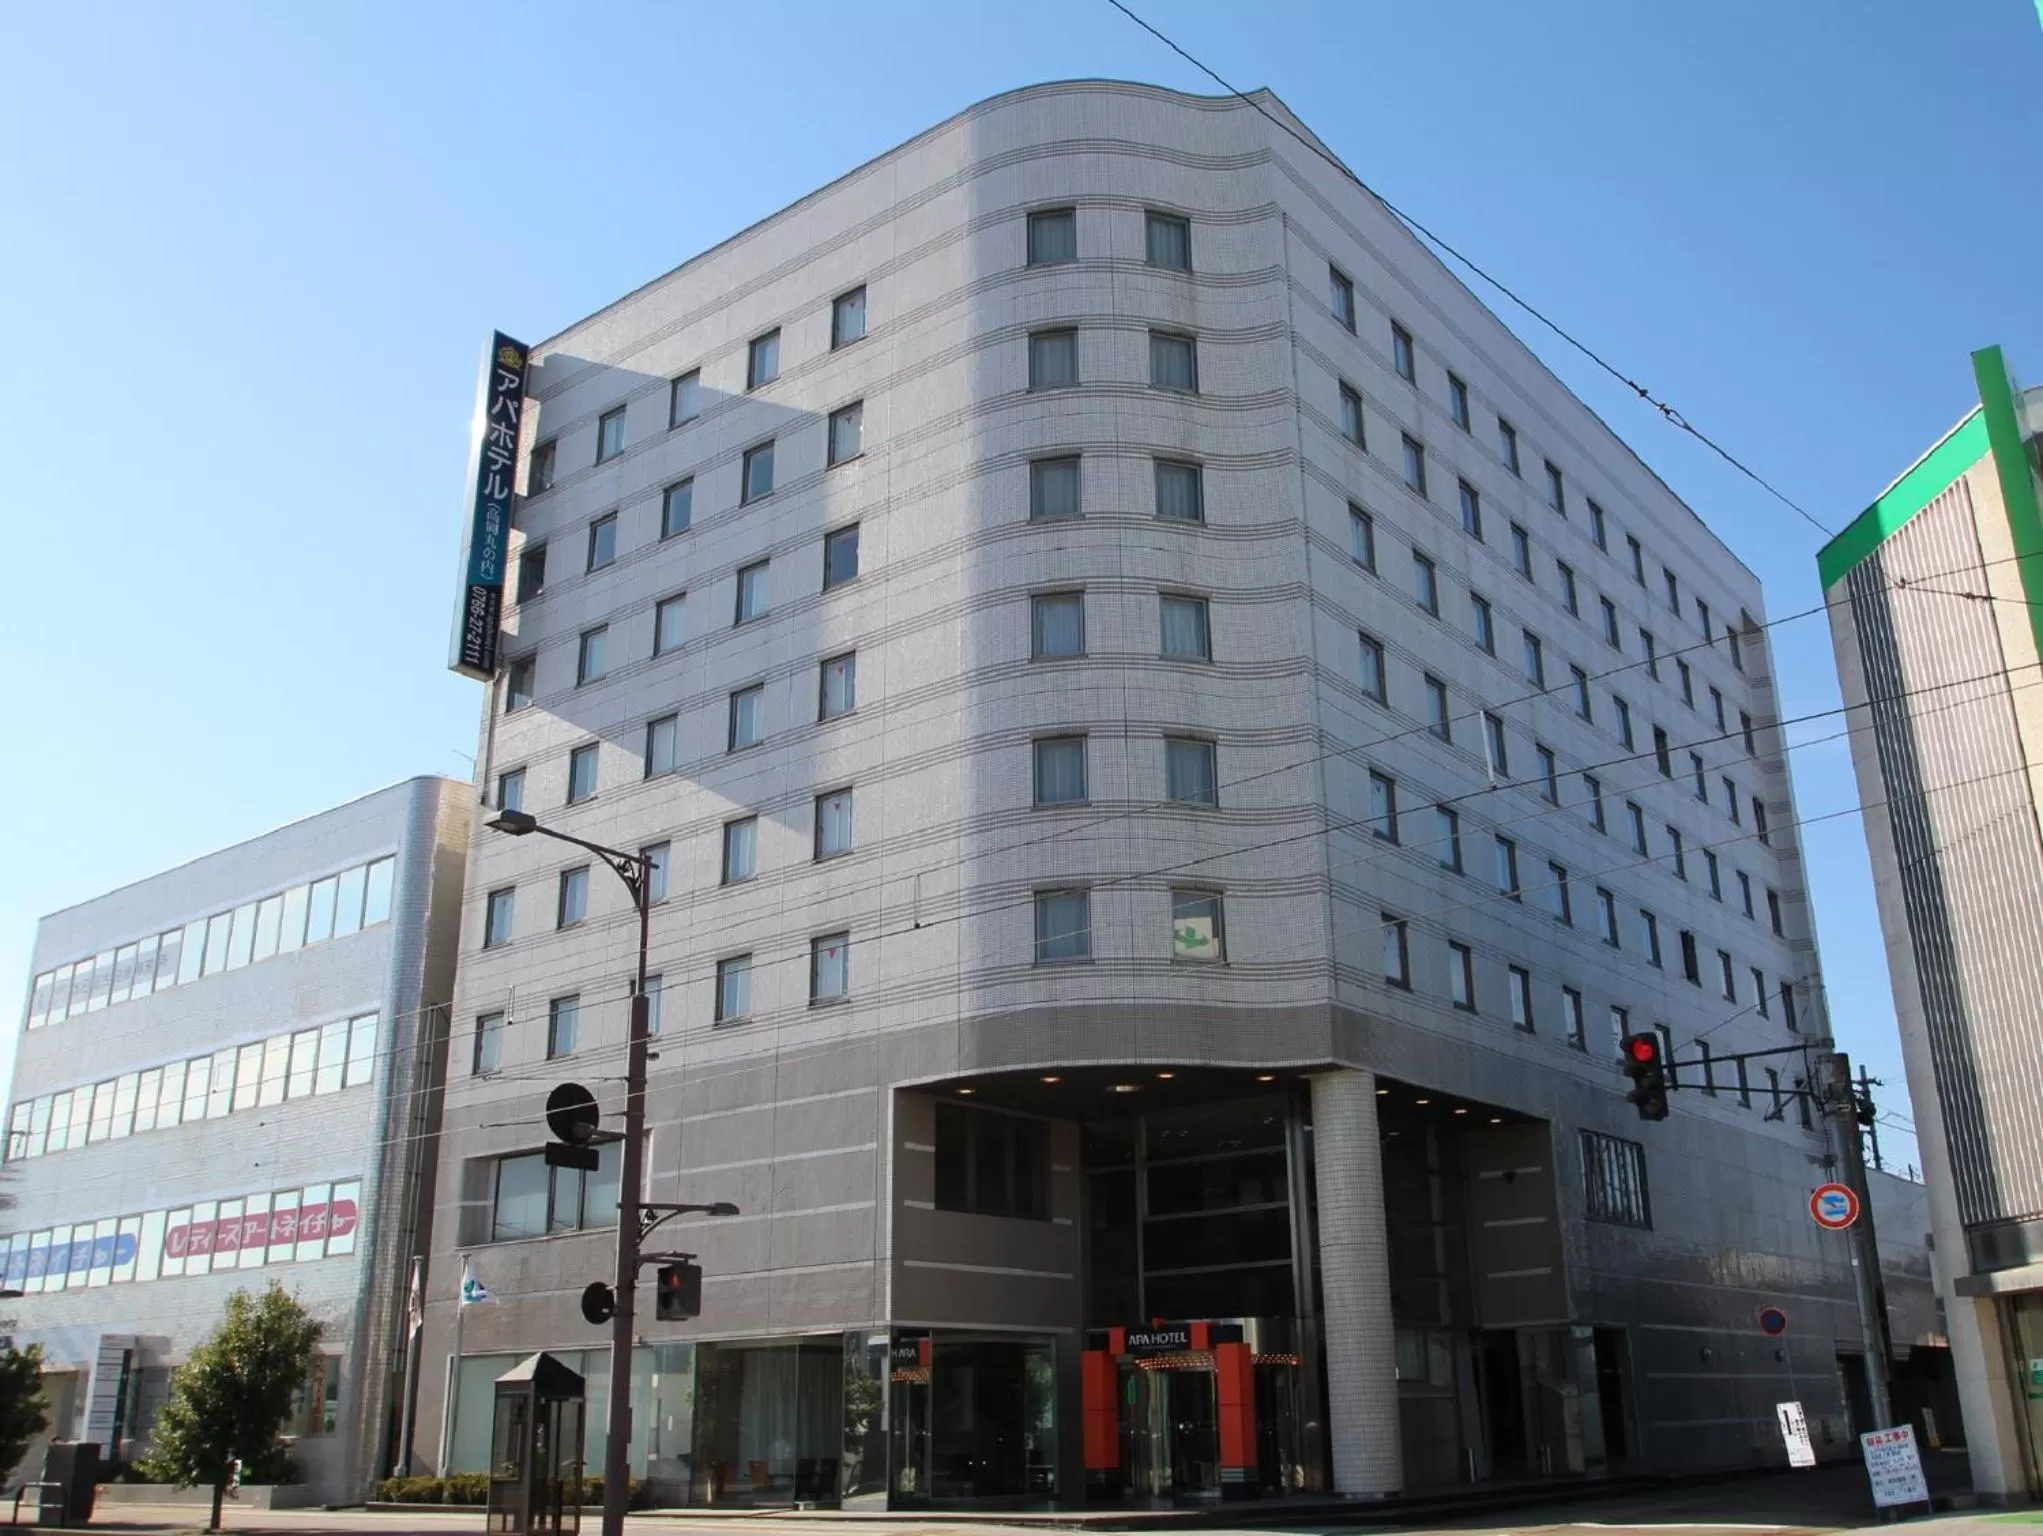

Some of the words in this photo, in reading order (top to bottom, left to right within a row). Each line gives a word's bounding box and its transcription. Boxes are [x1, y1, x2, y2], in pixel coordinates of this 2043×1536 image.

[484, 367, 520, 500] アパホテル
[464, 585, 488, 665] 0766-27-2111
[172, 1211, 356, 1253] レディースアートネイチャー
[1128, 1334, 1150, 1346] APA
[1151, 1331, 1189, 1345] HOTEL
